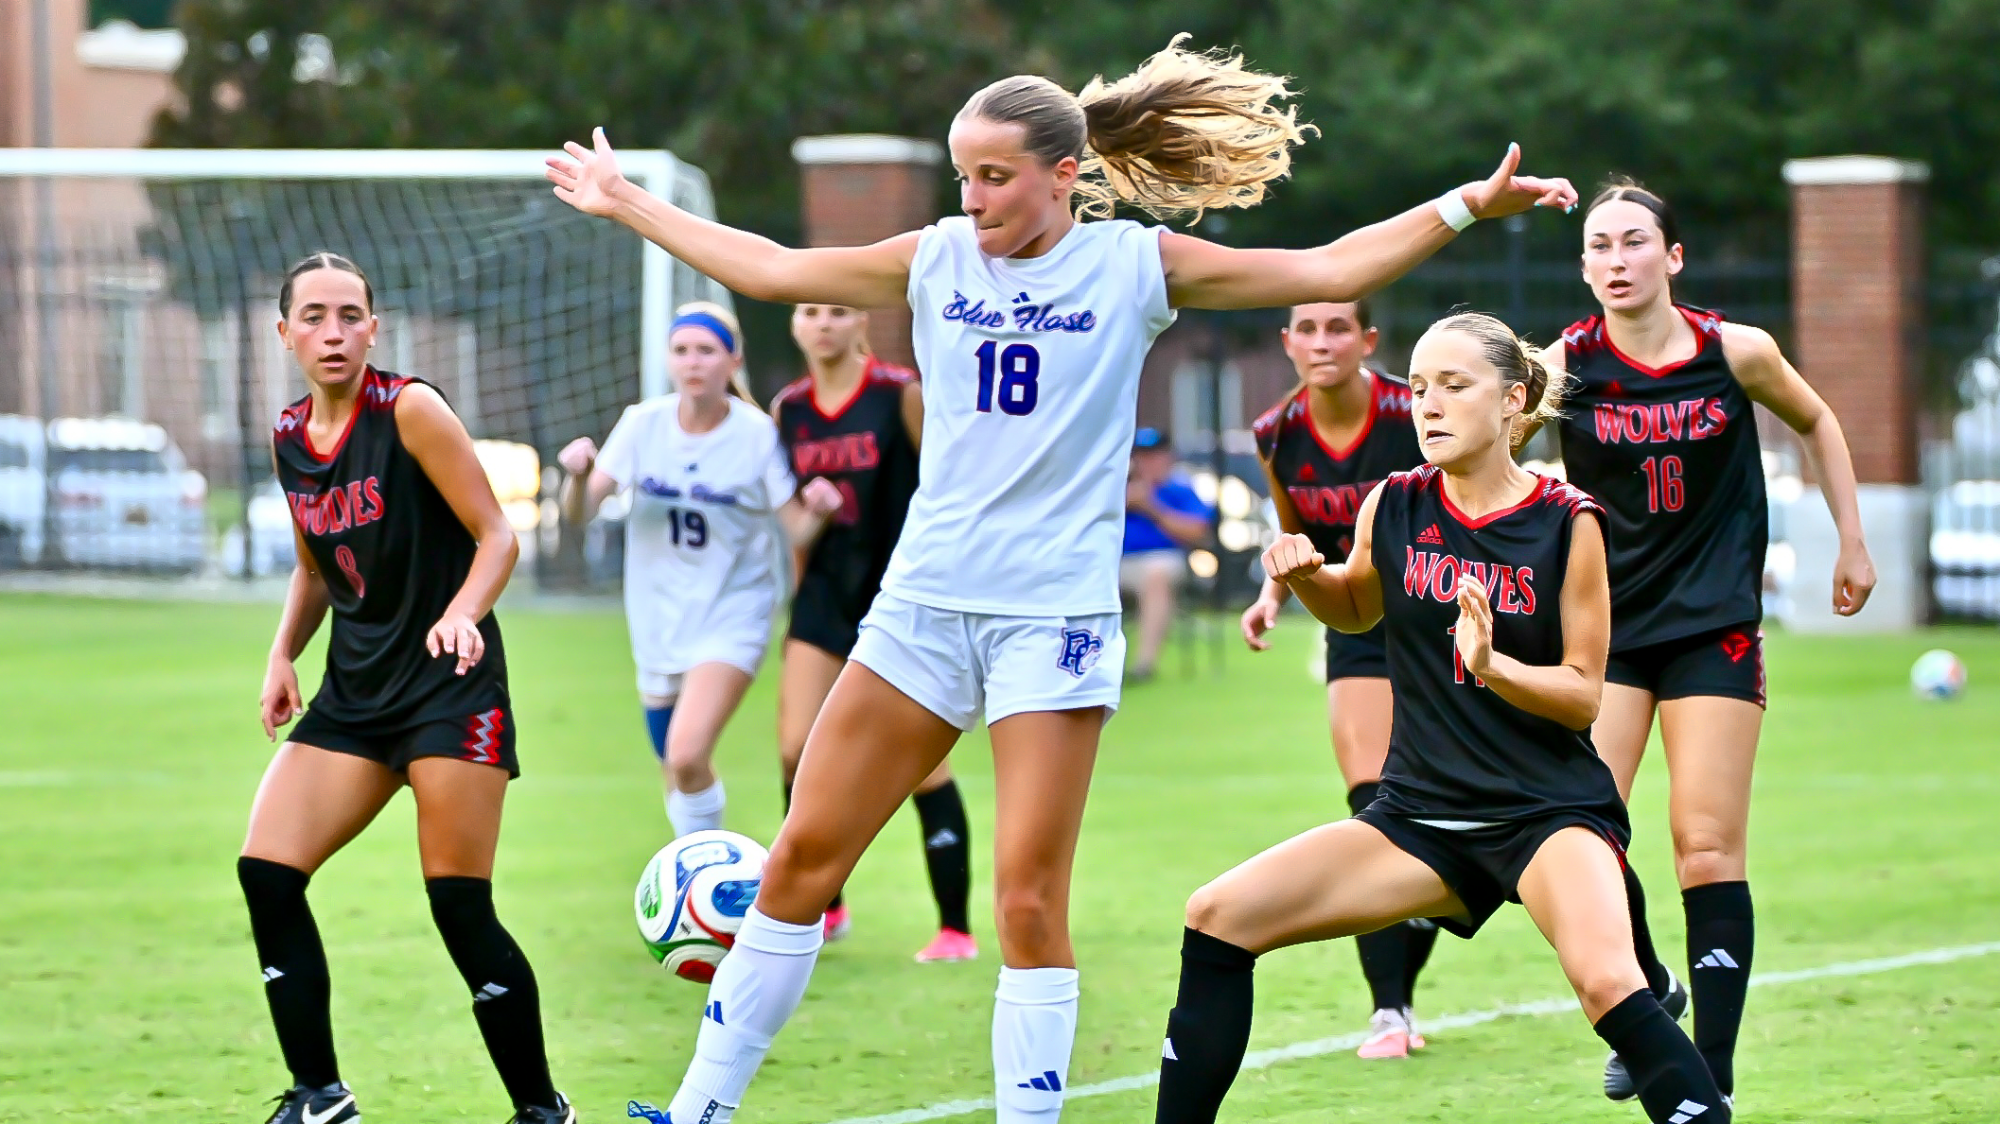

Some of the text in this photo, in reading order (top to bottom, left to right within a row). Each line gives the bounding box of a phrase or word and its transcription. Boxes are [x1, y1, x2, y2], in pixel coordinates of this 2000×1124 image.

[942, 289, 1098, 333] Blue Hose
[974, 340, 1041, 416] 18
[1593, 397, 1727, 444] WOLVES
[1640, 455, 1685, 514] 16
[668, 507, 709, 548] 19
